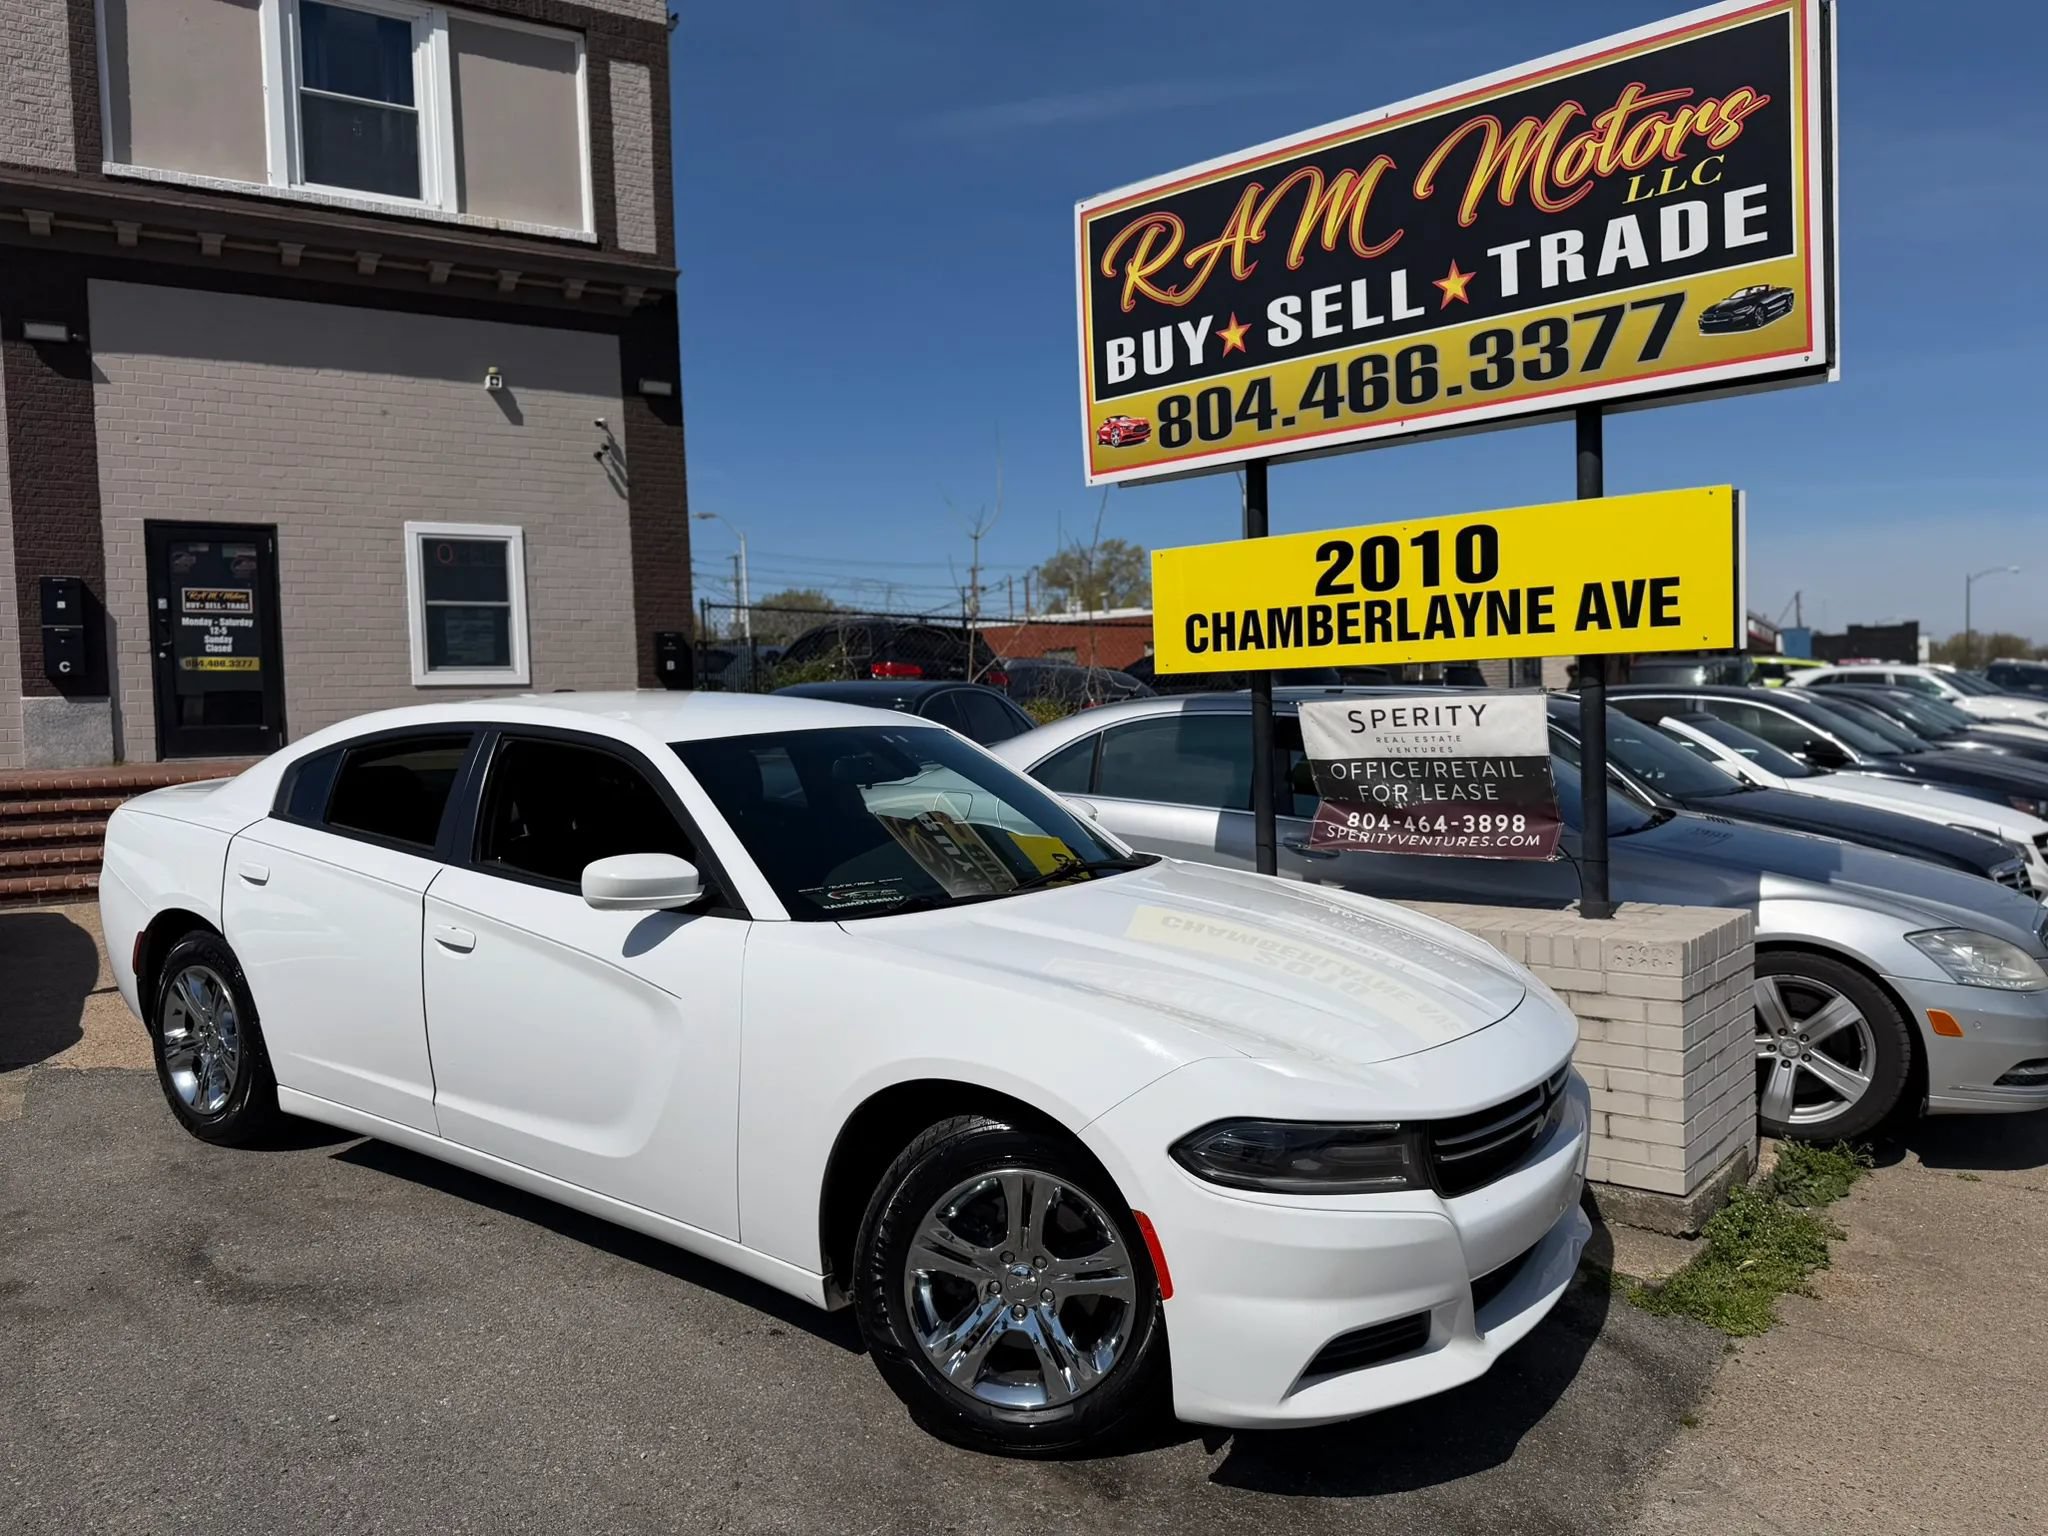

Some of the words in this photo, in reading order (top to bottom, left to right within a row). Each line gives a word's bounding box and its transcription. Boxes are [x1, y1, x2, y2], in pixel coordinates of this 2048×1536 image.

[1621, 155, 1725, 206] LLC
[1101, 155, 1404, 312] RAM
[1414, 82, 1770, 228] Motors
[1106, 313, 1215, 386] BUY
[1266, 269, 1426, 349] SELL
[1486, 182, 1769, 298] TRADE
[1157, 290, 1689, 450] 804.466.3377
[1314, 523, 1499, 598] 2010
[181, 617, 213, 627] Monday
[219, 617, 254, 628] Saturday
[1185, 585, 1556, 654] CHAMBERLAYNE
[1574, 576, 1681, 631] AVE
[204, 635, 233, 644] Sunday
[205, 644, 232, 653] Closed
[59, 661, 71, 673] C
[1347, 704, 1488, 734] SPERITY
[1376, 736, 1408, 744] REAL
[1414, 734, 1463, 743] ESTATE
[1386, 746, 1454, 754] VENTURES
[1330, 761, 1524, 780] OFFICE/RETAIL
[1358, 784, 1409, 802] FOR
[1419, 783, 1500, 801] LEASE
[1347, 811, 1526, 834] 804-464-3898
[1327, 825, 1541, 848] SPERITYVENTURES.COM
